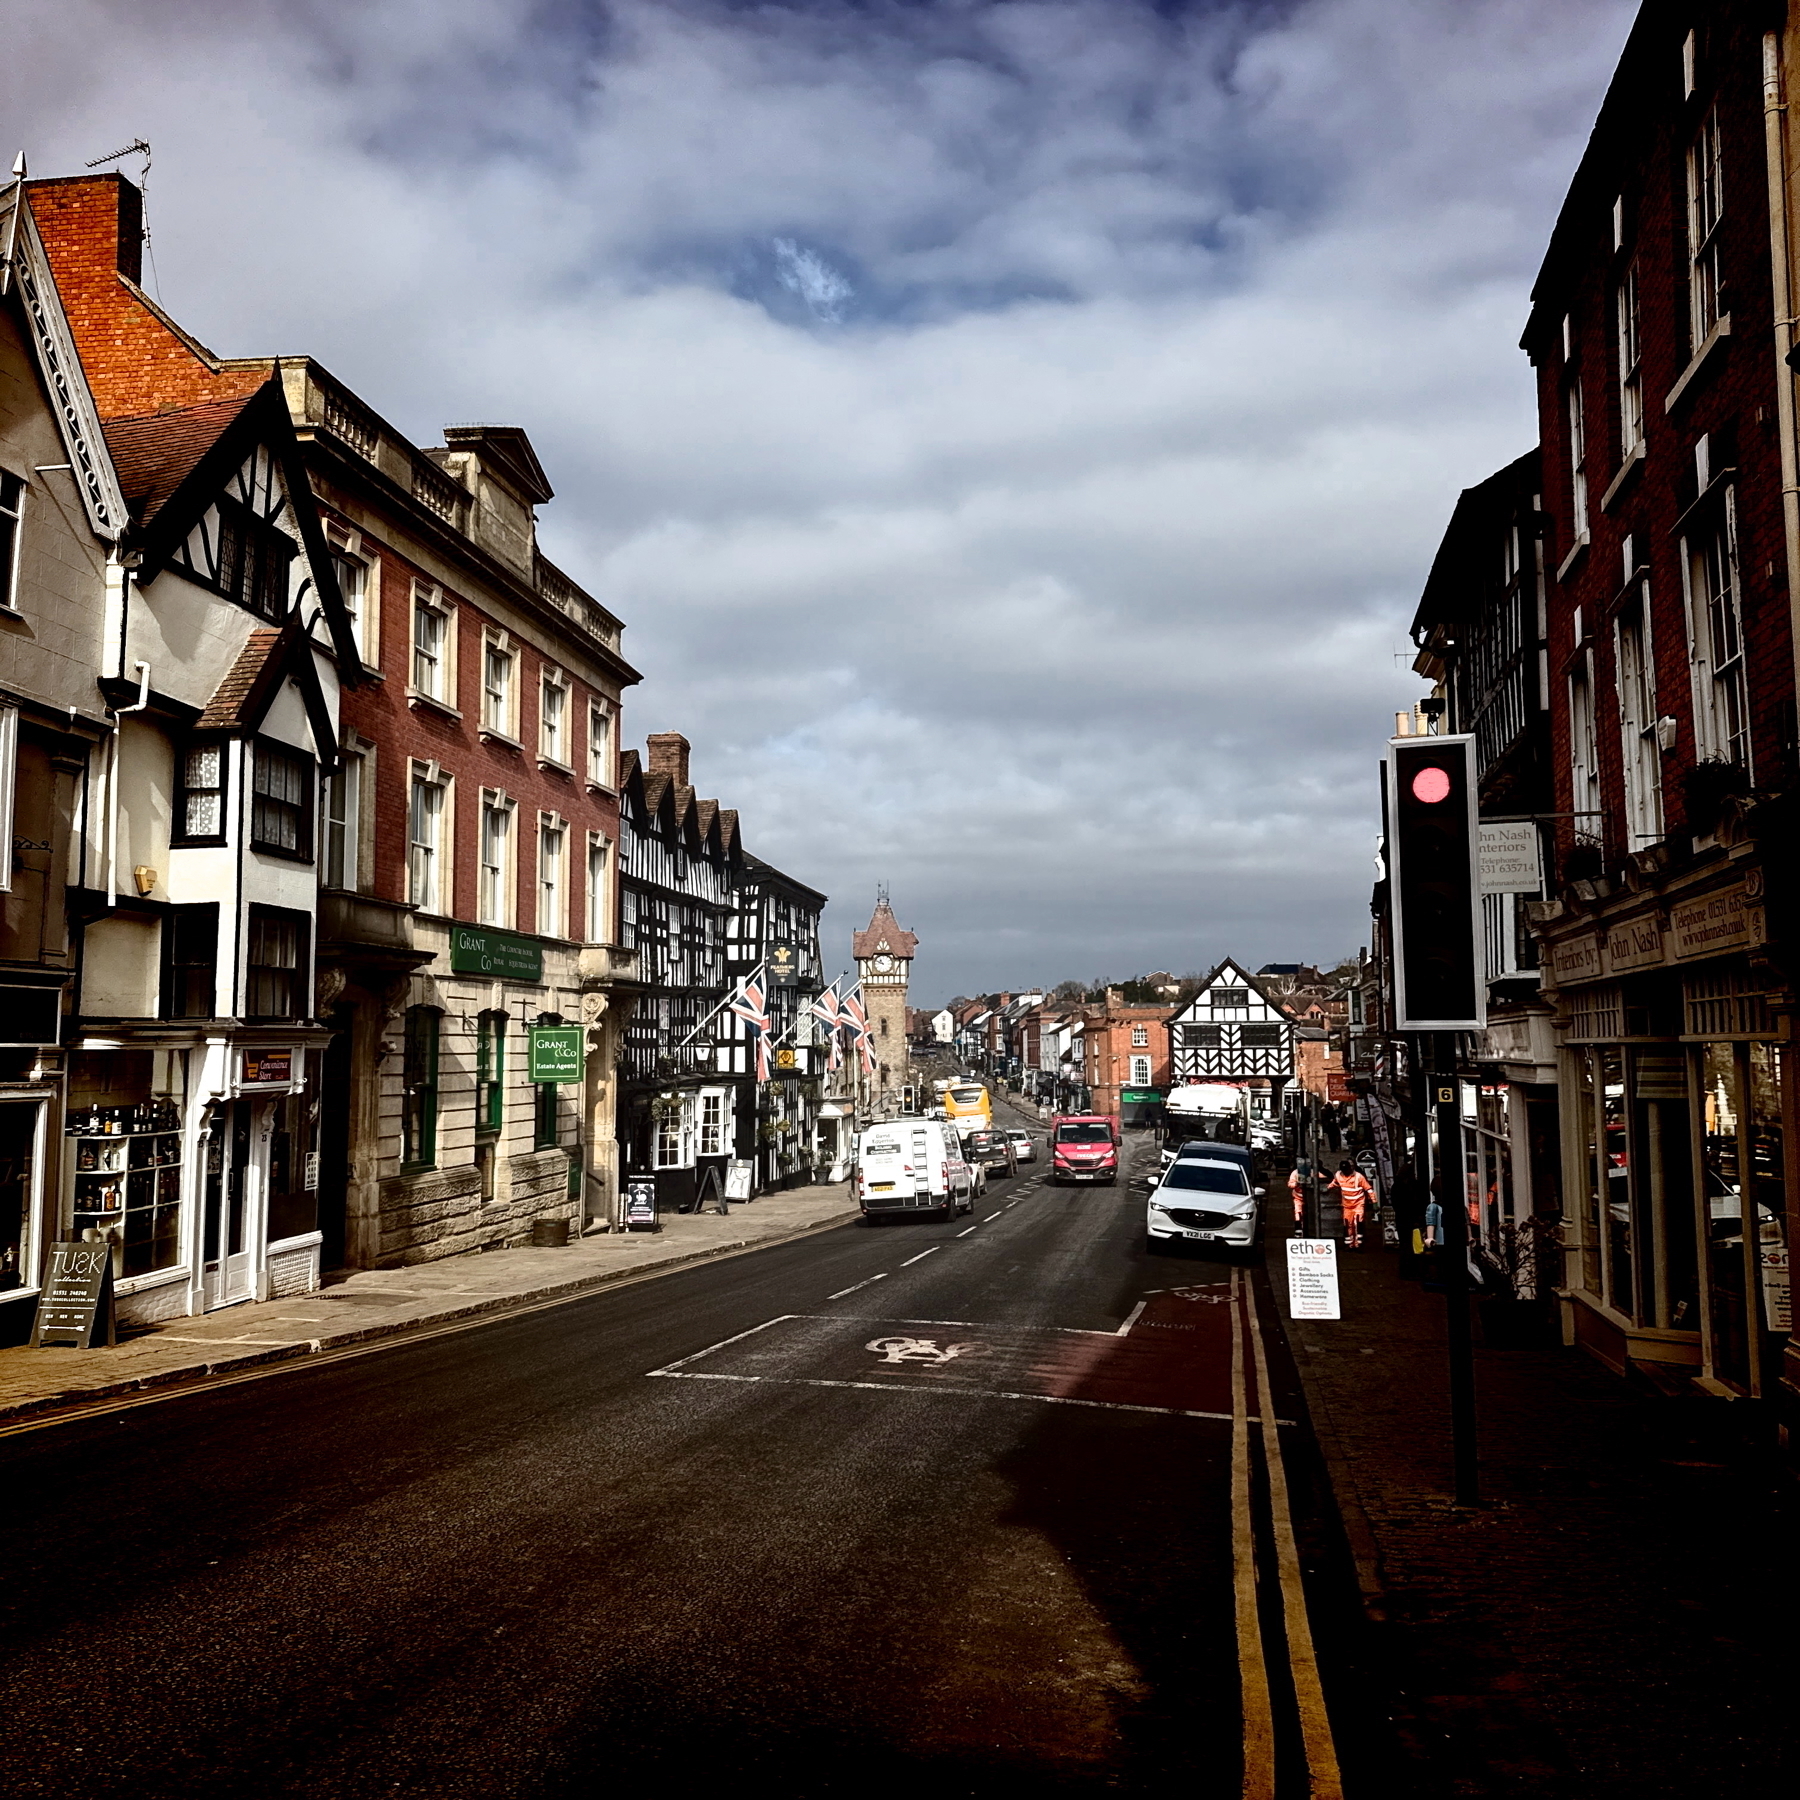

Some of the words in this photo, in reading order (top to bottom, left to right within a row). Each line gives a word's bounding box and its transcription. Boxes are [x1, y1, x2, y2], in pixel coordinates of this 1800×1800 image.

[1479, 832, 1495, 842] hn
[1499, 829, 1531, 841] Nash
[1479, 842, 1526, 853] nteriors
[1480, 864, 1496, 874] 531
[1499, 863, 1534, 873] 635714
[1673, 908, 1707, 932] Telephone
[1708, 898, 1727, 919] 01531
[1609, 933, 1631, 966] John
[1631, 923, 1660, 954] Nash
[1554, 947, 1584, 972] Interiors
[556, 1063, 577, 1071] Agents
[259, 1071, 272, 1080] Store
[1441, 1089, 1451, 1101] 6
[1290, 1241, 1332, 1255] ethos
[53, 1252, 104, 1273] TUSK
